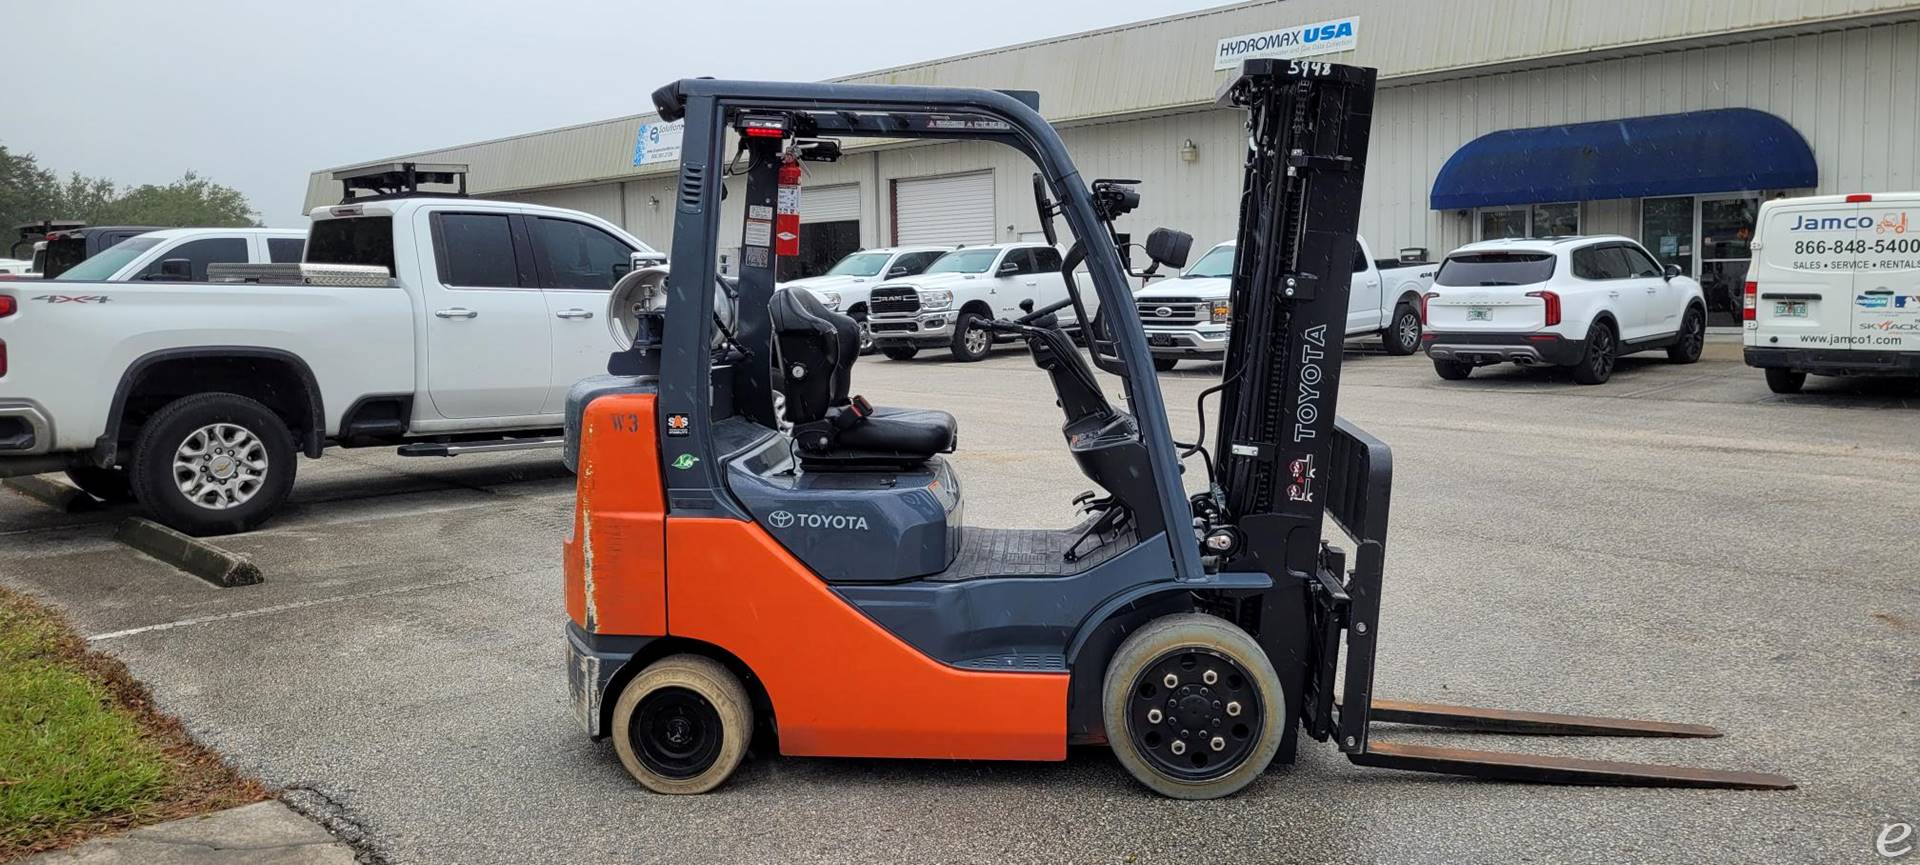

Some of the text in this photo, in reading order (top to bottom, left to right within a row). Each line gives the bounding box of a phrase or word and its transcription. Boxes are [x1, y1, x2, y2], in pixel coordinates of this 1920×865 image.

[1220, 22, 1352, 57] HYDROMAX USA
[1288, 60, 1332, 78] 5948
[1790, 215, 1874, 231] Jamco
[1794, 239, 1920, 255] 866-848-5400
[1793, 260, 1920, 270] SALES SERVICE RENTALS
[1800, 335, 1903, 346] www.jamco1.com
[1294, 324, 1327, 442] TOYOTA
[668, 415, 689, 428] SAS
[797, 513, 868, 530] TOYOTA
